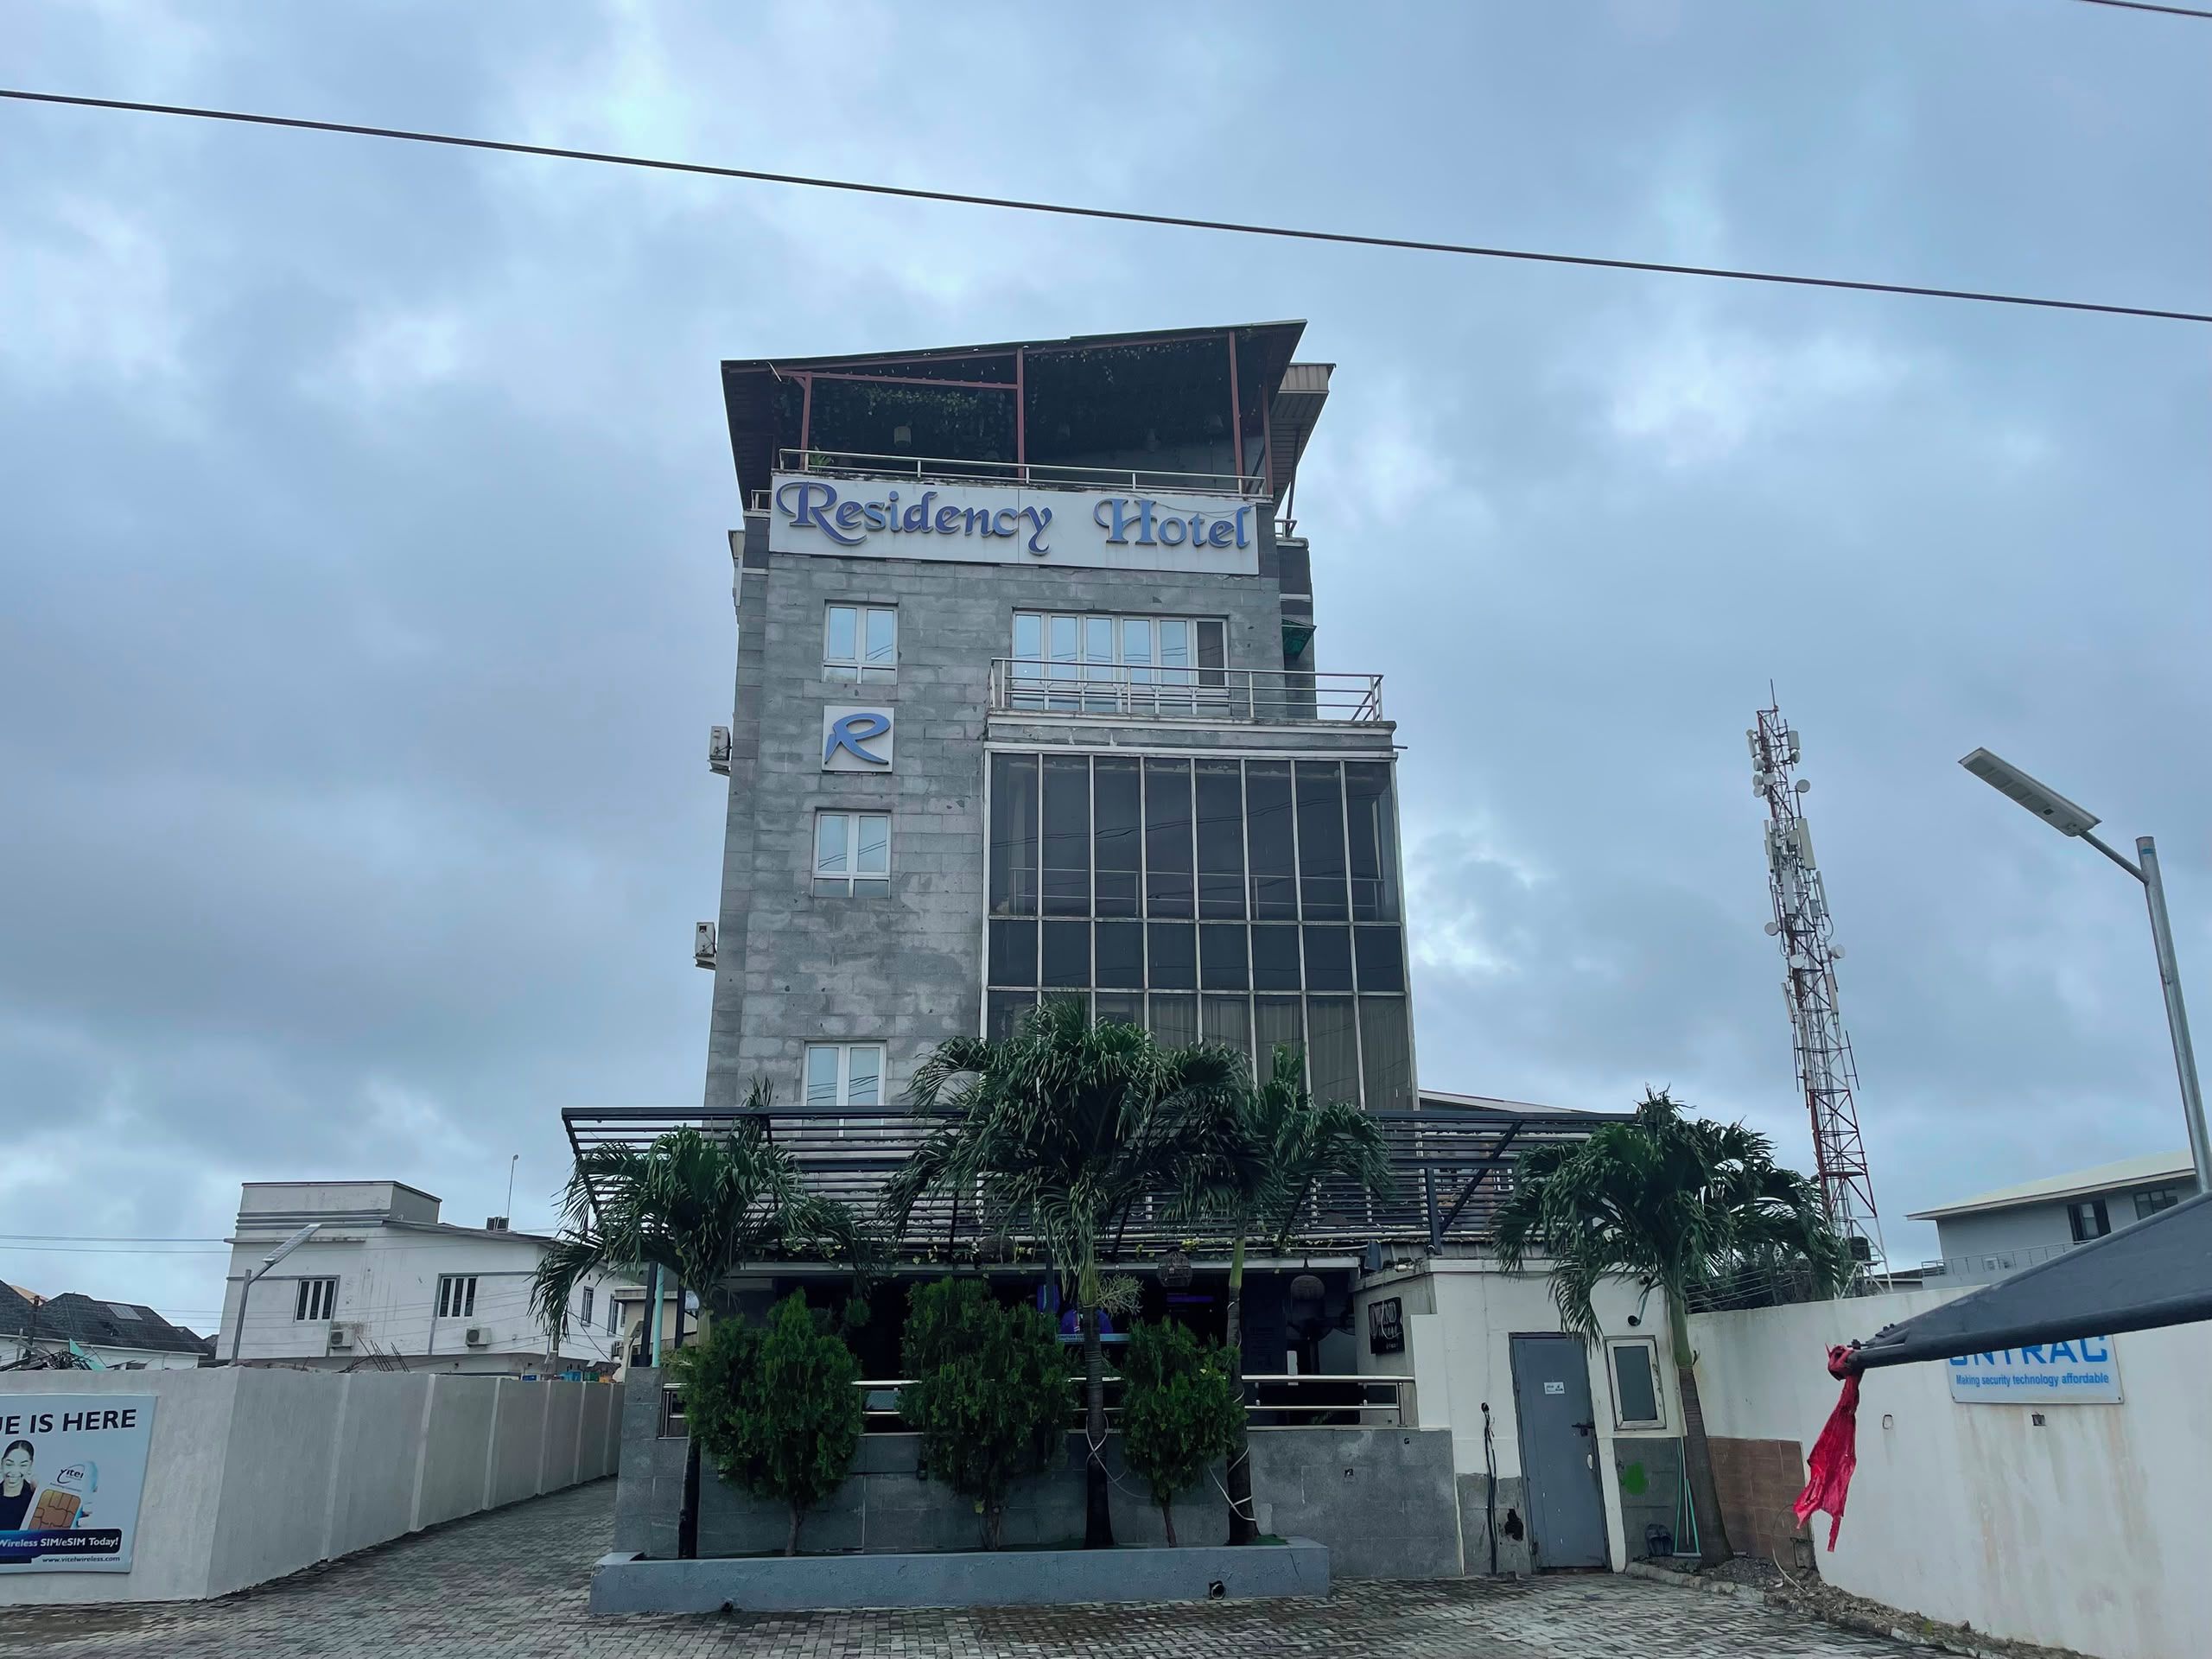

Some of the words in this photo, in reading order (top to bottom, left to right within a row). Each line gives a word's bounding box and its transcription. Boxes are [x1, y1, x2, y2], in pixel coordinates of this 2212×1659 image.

[776, 481, 1052, 556] Residency
[1093, 498, 1252, 549] Hotel
[824, 713, 891, 765] R
[1955, 1375, 1980, 1388] Making
[1981, 1374, 2011, 1387] security
[2012, 1373, 2059, 1387] technology
[2062, 1372, 2109, 1384] affordable
[29, 1414, 54, 1433] IS
[62, 1408, 137, 1432] HERE
[41, 1538, 86, 1547] SIM/eSIM
[89, 1537, 119, 1548] Today!
